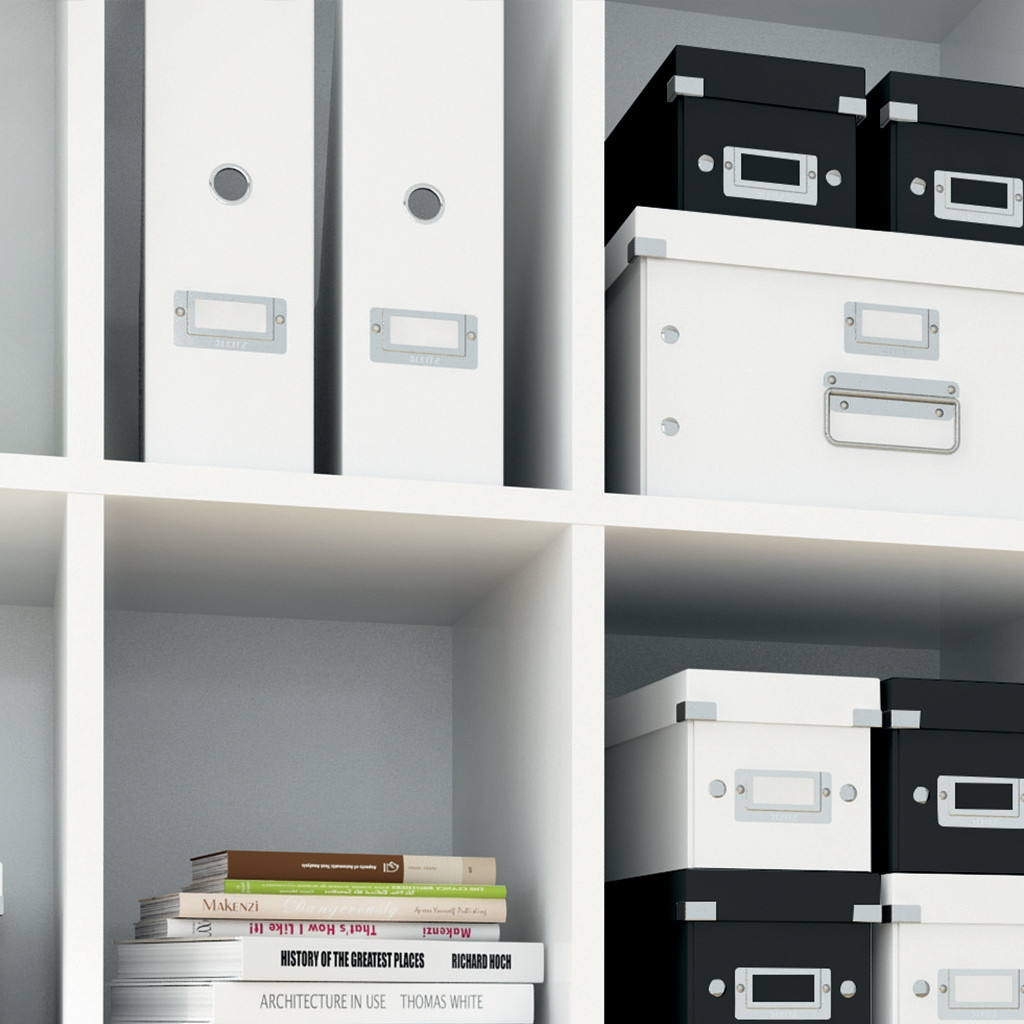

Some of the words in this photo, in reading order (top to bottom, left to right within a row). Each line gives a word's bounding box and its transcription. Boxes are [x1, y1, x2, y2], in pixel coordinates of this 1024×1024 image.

[249, 923, 264, 934] It!
[268, 922, 295, 935] Like
[299, 923, 304, 935] I
[307, 923, 336, 936] How
[339, 923, 377, 937] That's
[422, 926, 471, 939] Makenzi
[281, 950, 319, 968] HISTORY
[321, 951, 332, 968] OF
[333, 951, 350, 968] THE
[351, 952, 392, 969] GREATEST
[394, 952, 425, 969] PLACES
[452, 953, 488, 970] RICHARD
[489, 954, 512, 970] HOCH
[260, 994, 347, 1009] ARCHITECTURE
[351, 994, 361, 1009] IN
[366, 994, 386, 1009] USE
[400, 994, 447, 1009] THOMAS
[450, 994, 483, 1009] WHITE
